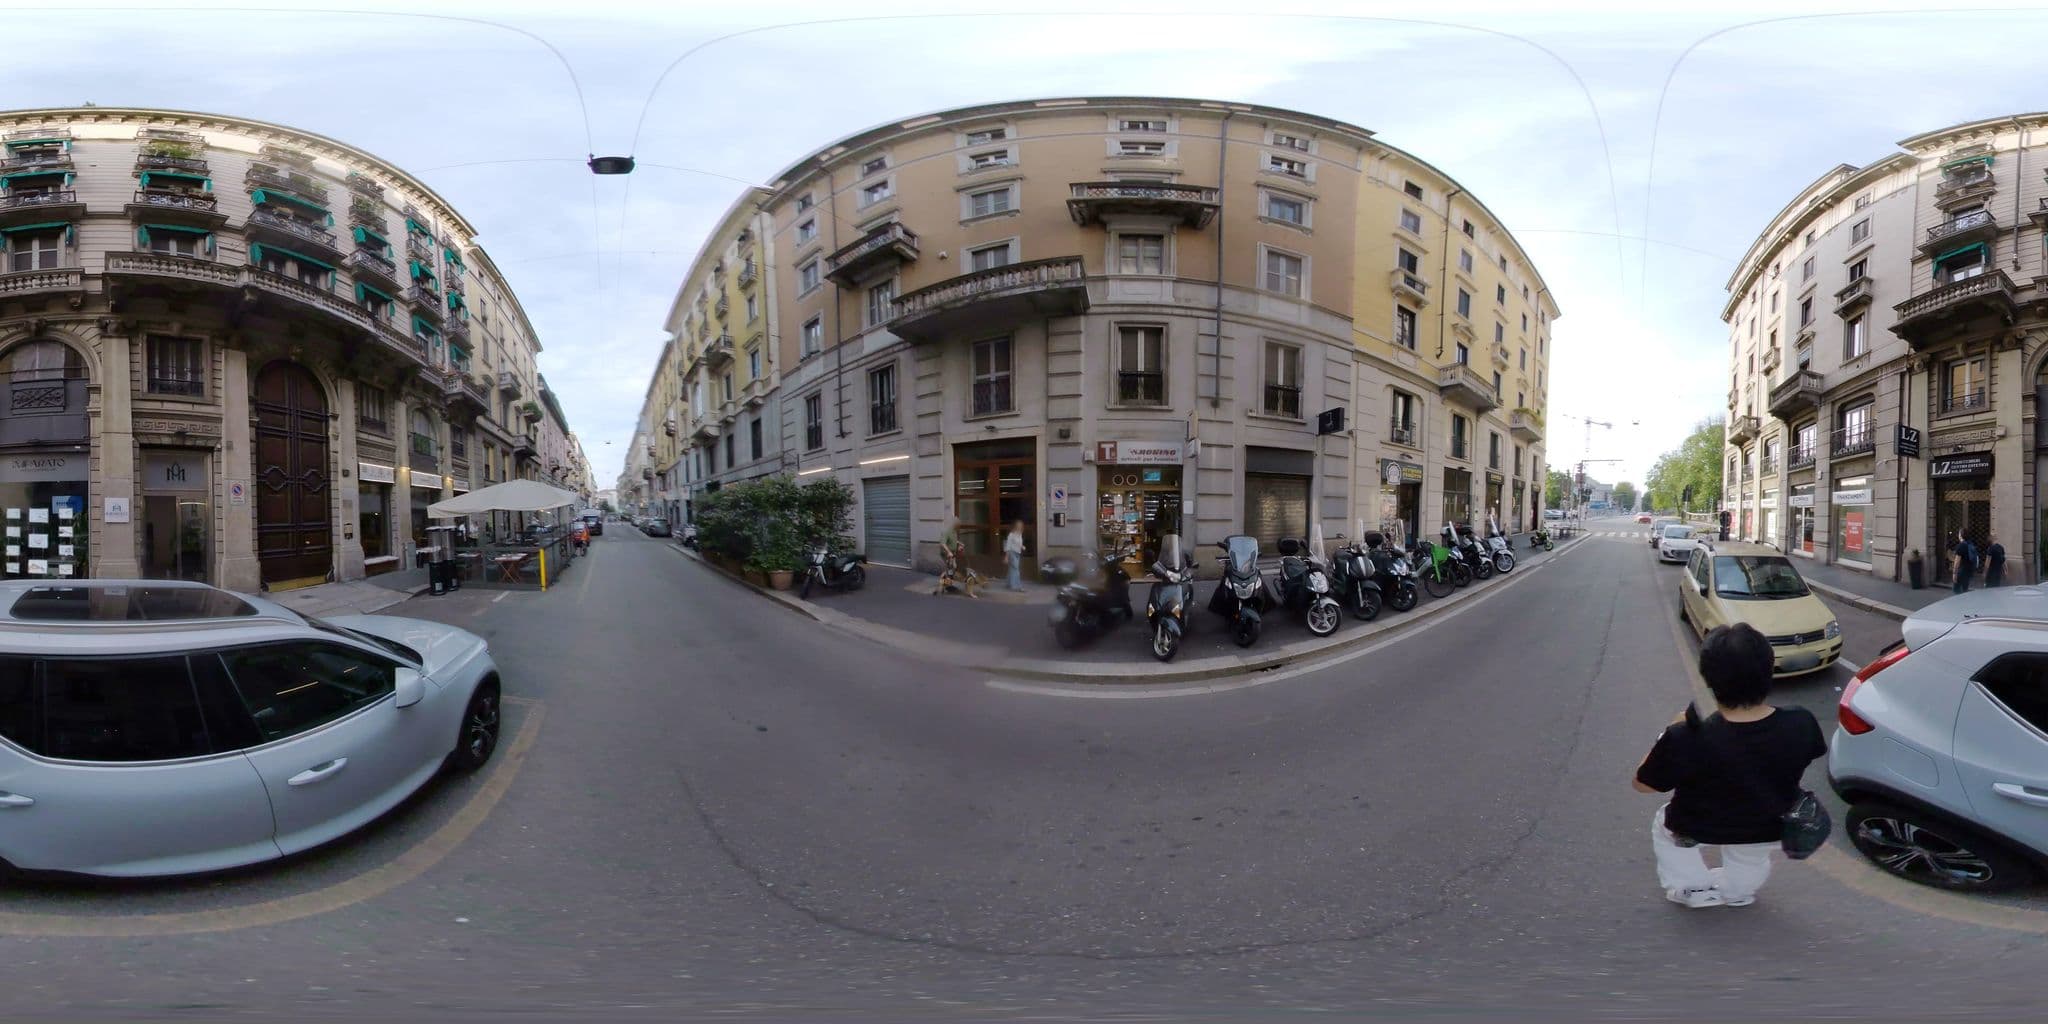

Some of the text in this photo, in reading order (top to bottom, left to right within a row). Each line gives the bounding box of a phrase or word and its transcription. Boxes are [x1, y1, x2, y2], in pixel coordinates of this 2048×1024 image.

[1901, 427, 1917, 442] LZ
[1101, 444, 1114, 460] T
[1931, 461, 1951, 475] LZ
